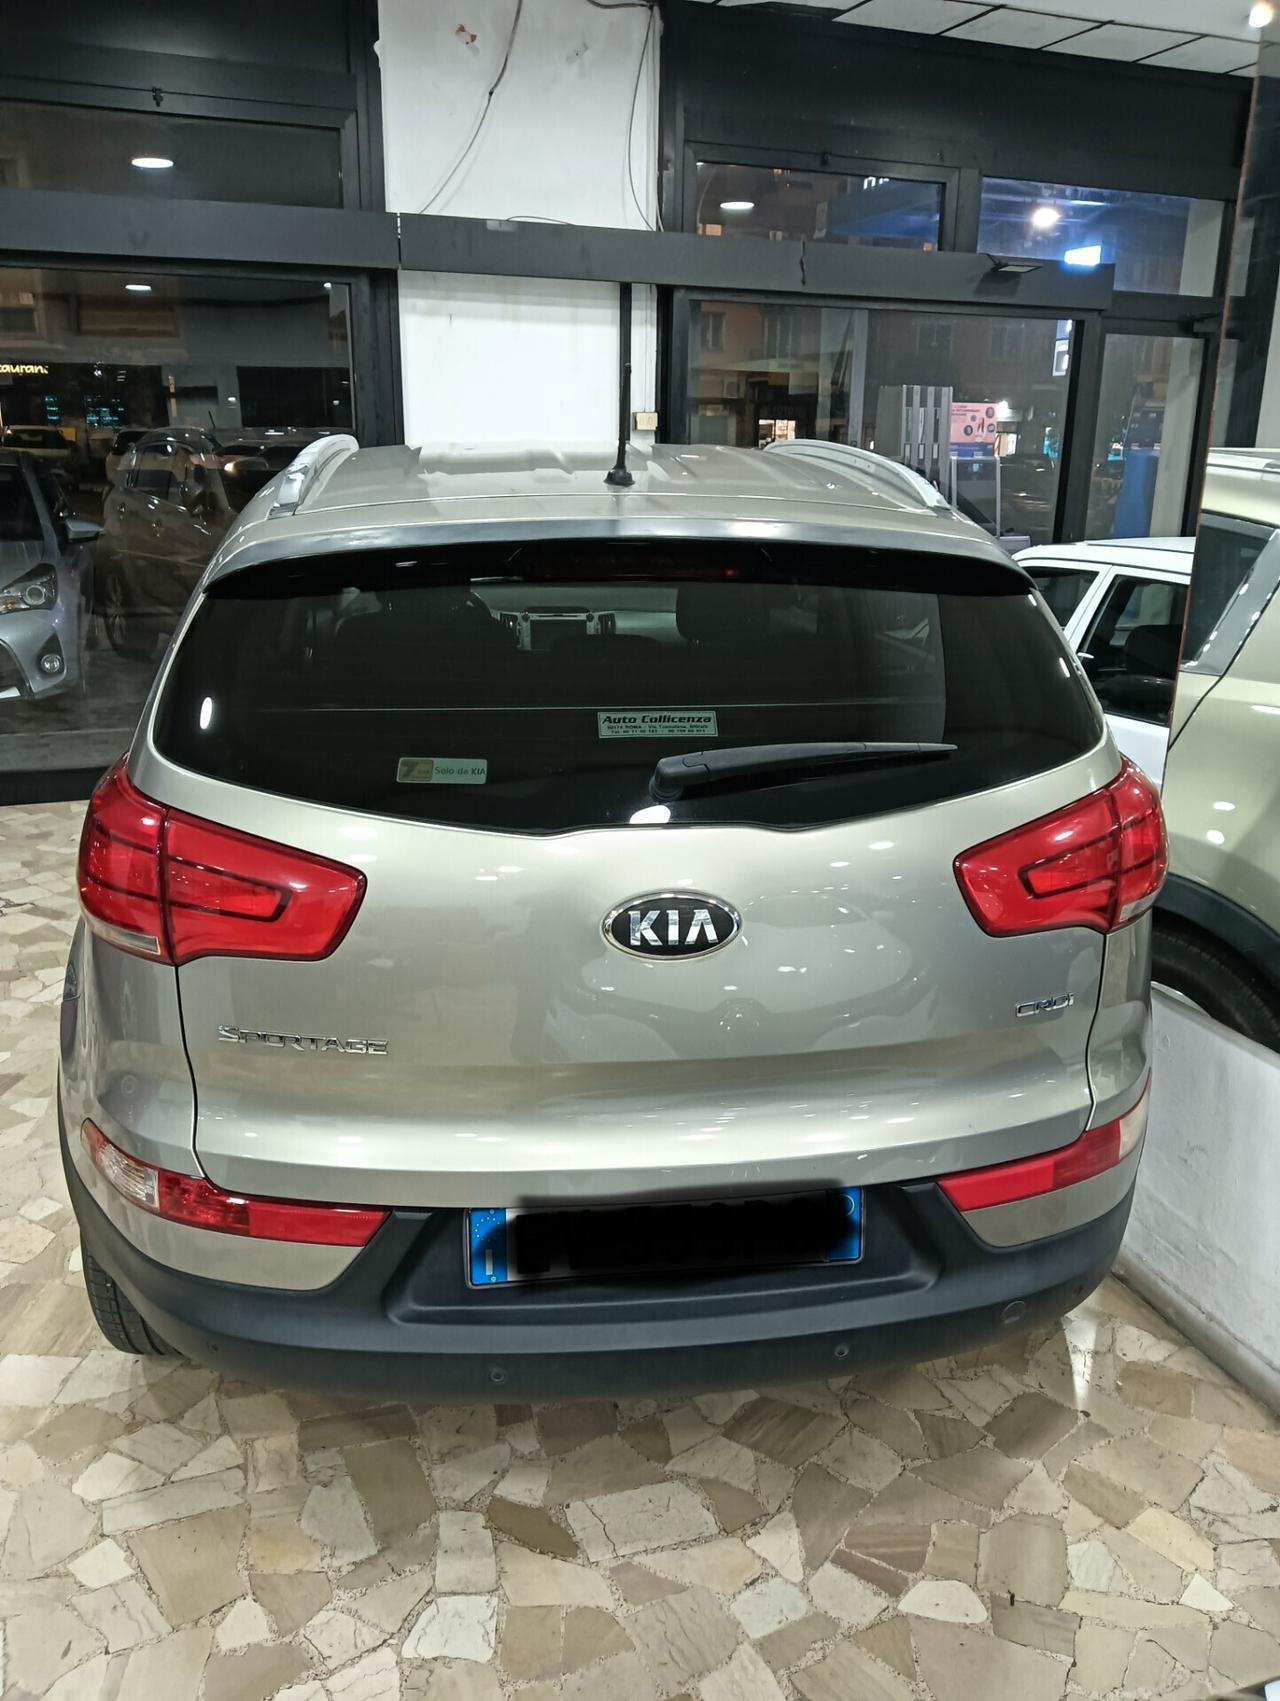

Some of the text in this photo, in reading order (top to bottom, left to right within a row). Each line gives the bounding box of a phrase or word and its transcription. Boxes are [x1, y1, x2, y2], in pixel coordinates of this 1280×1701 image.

[602, 714, 712, 724] Auto Collicenza
[434, 767, 455, 775] Solo
[627, 909, 719, 946] KIA
